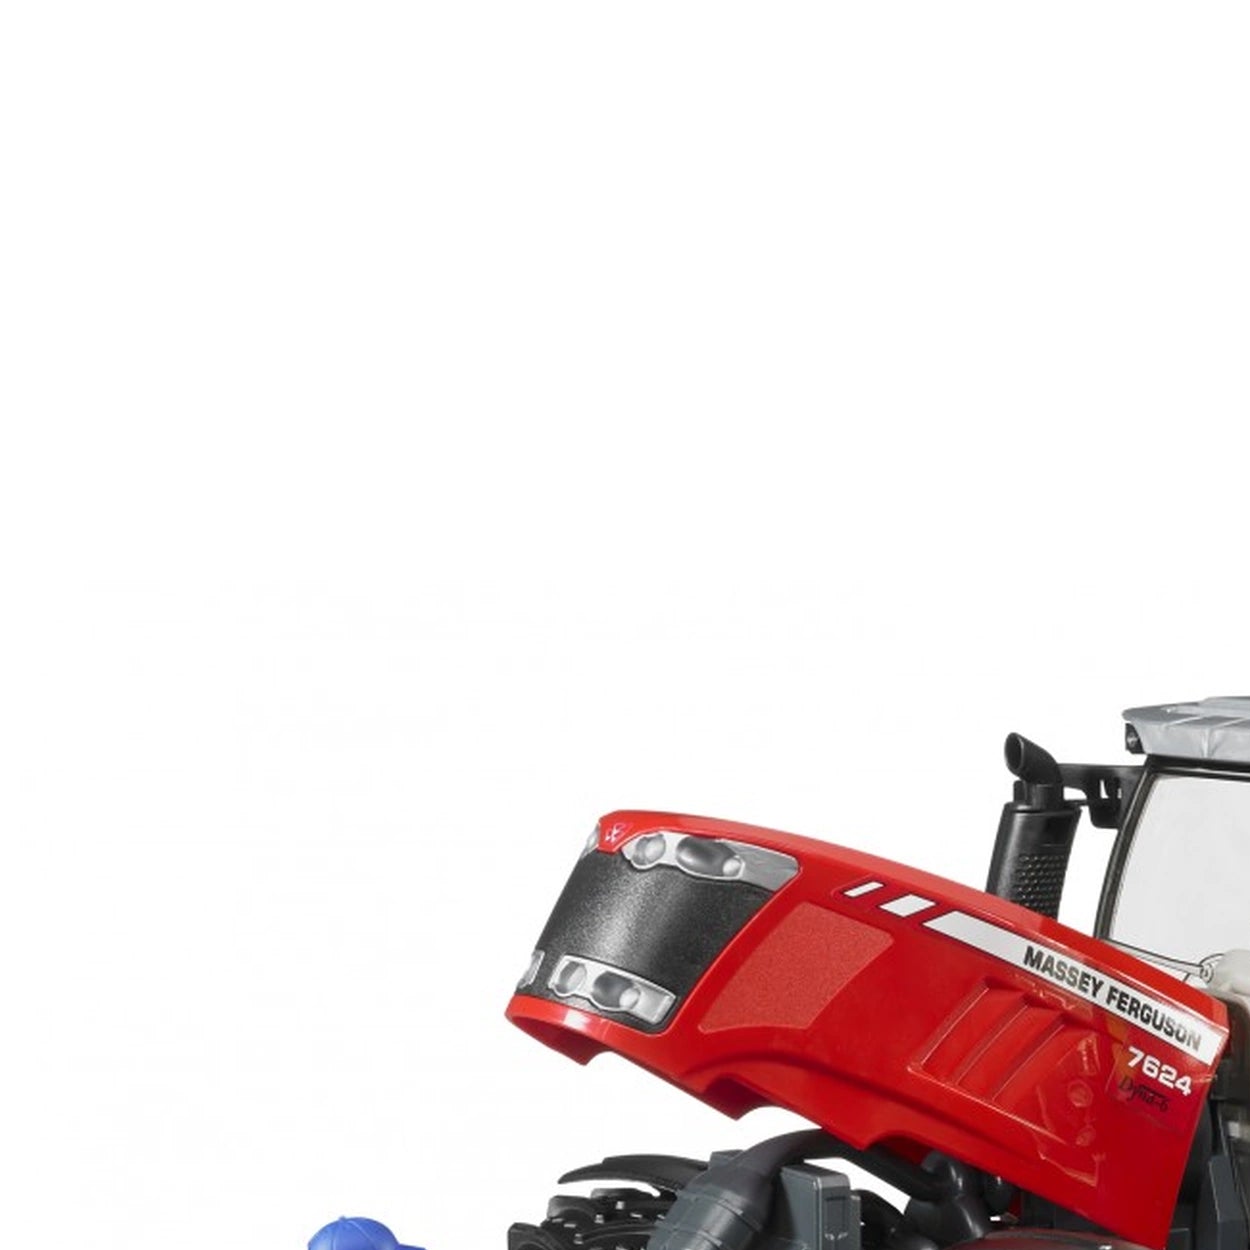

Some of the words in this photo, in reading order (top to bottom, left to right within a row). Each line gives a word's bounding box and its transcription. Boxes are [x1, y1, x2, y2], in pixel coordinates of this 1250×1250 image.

[1023, 945, 1104, 998] MASSEY
[1106, 986, 1201, 1051] FERGUSON
[1127, 1045, 1192, 1096] 7624
